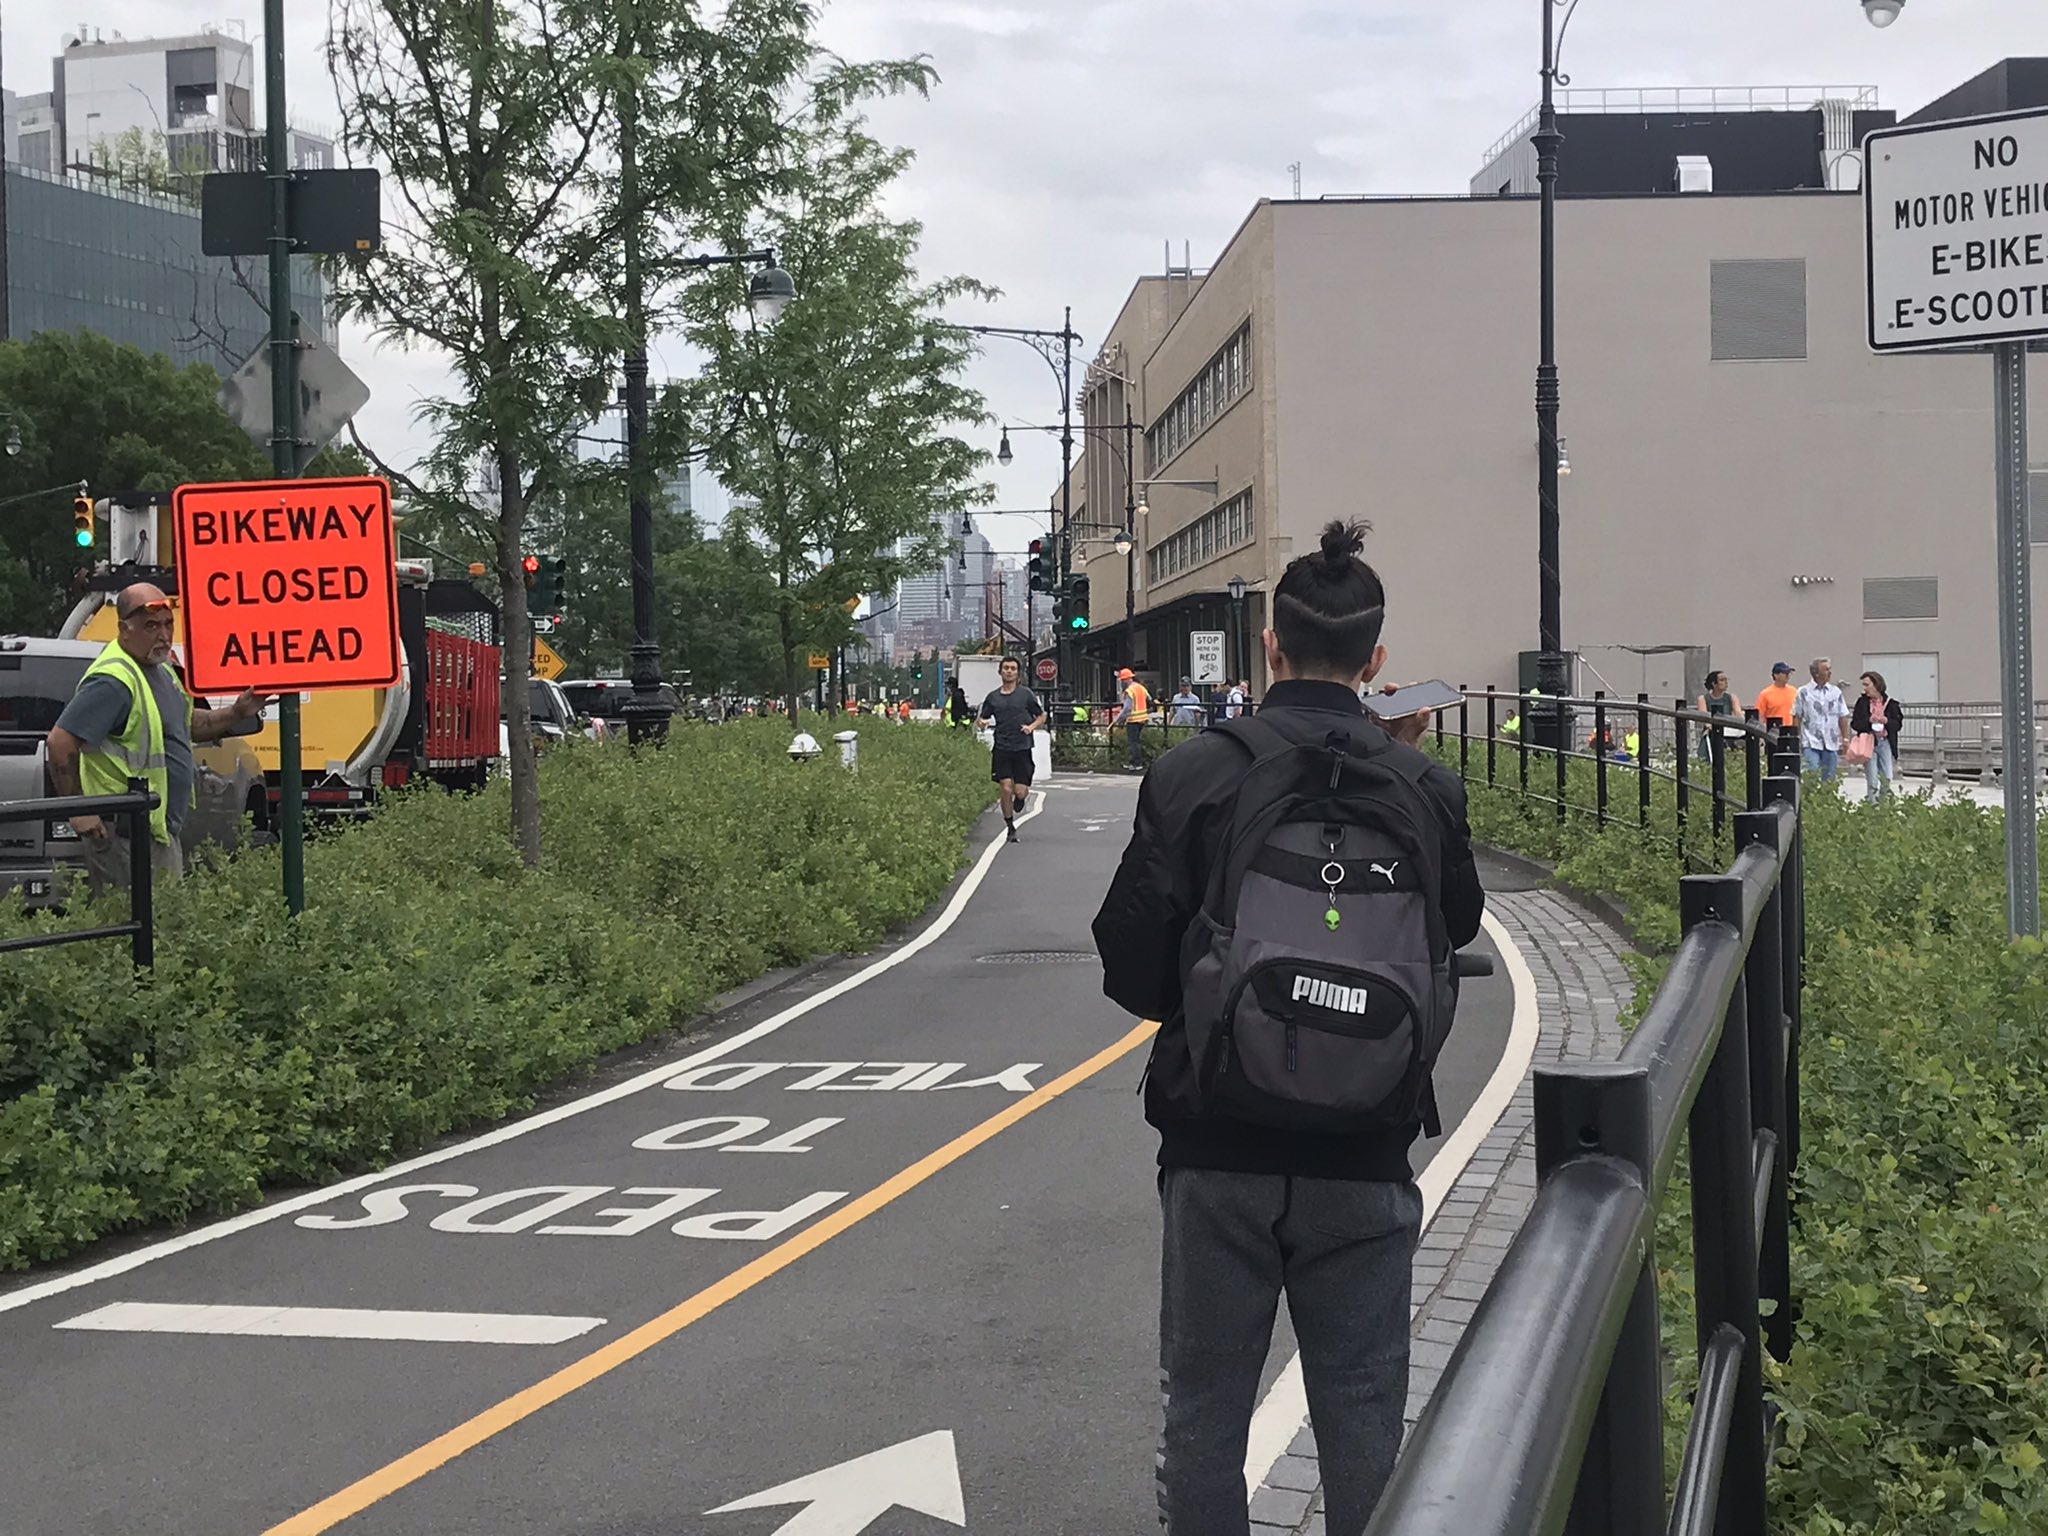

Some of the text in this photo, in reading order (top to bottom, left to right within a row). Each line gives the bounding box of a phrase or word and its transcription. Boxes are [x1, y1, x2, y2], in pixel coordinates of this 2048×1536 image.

[1974, 136, 2018, 169] NO
[1895, 191, 1974, 230] MOTOR
[1932, 234, 2048, 275] E-BIKE
[192, 504, 376, 545] BIKEWAY
[207, 565, 369, 606] CLOSED
[220, 627, 363, 667] AHEAD
[1196, 636, 1219, 644] STOP
[1199, 653, 1217, 661] RED
[1038, 665, 1056, 674] STOP
[1292, 975, 1367, 1014] PUMA
[662, 1062, 1044, 1091] YIELD
[631, 1116, 846, 1153] TO
[293, 1184, 850, 1241] PEDS
